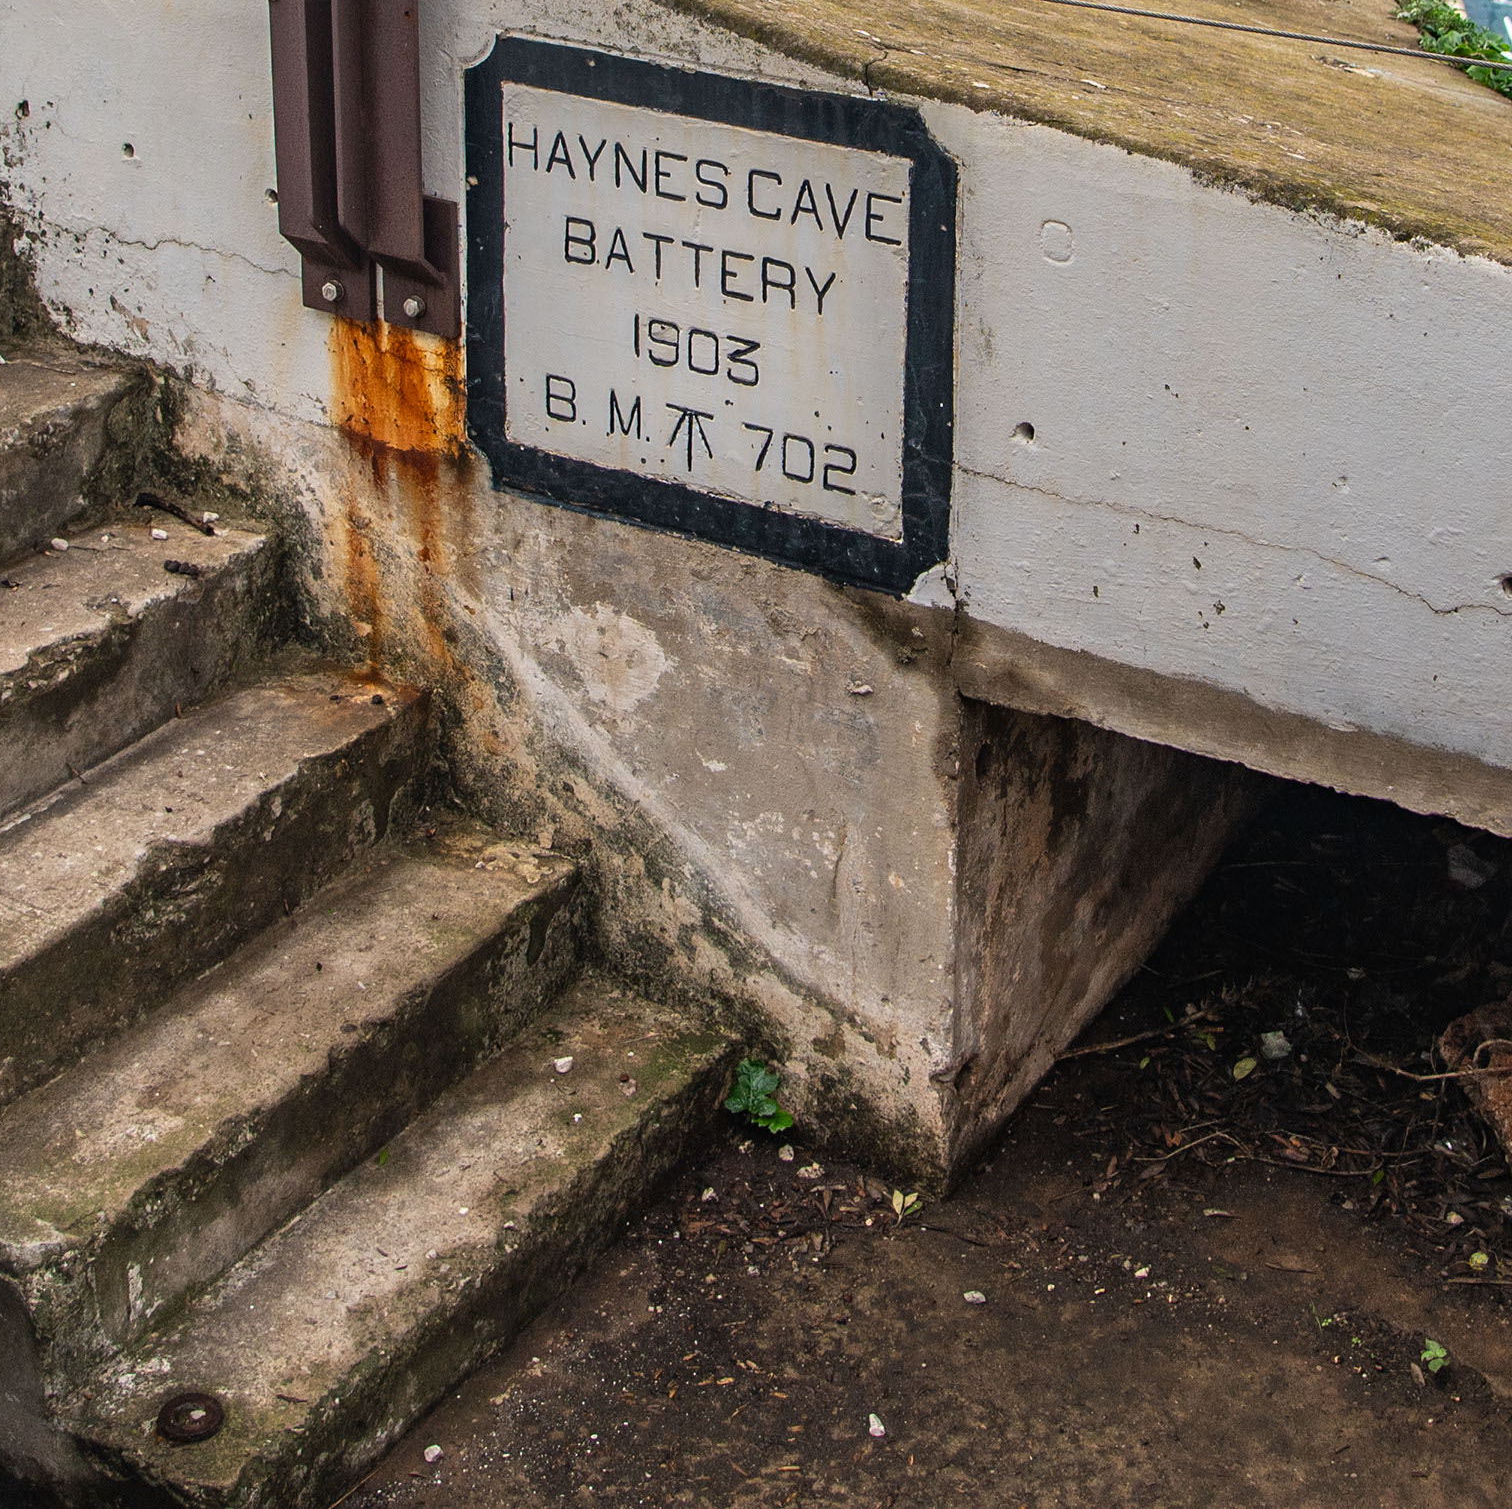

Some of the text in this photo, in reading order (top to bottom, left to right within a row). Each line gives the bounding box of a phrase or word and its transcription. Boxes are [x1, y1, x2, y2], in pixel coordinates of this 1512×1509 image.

[507, 122, 904, 246] HAYNES CAVE
[563, 217, 837, 315] BATTERY
[633, 313, 760, 387] 1903
[743, 422, 858, 496] 702
